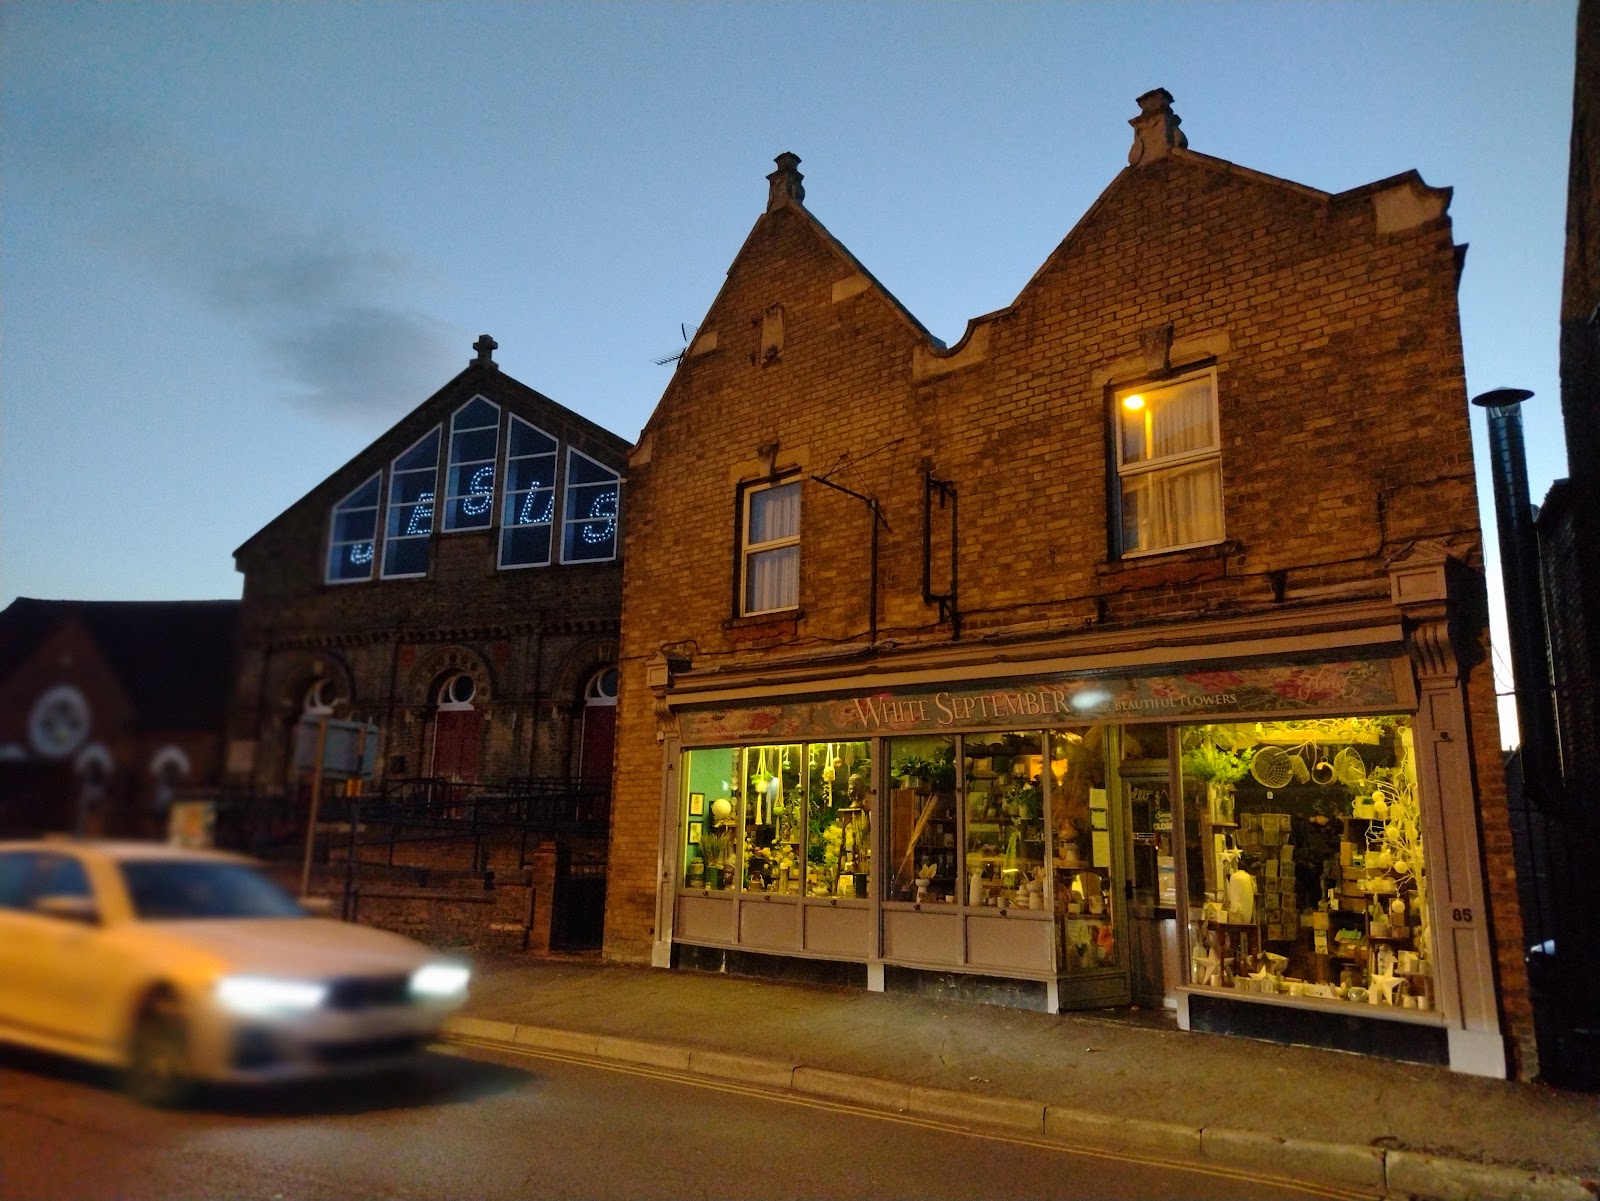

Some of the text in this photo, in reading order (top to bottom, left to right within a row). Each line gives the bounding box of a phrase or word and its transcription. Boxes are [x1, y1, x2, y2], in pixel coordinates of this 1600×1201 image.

[852, 690, 1070, 728] WHITE SEPTEMBER
[1114, 697, 1176, 711] BEAUTIFUL
[1181, 693, 1237, 707] FLOWERS
[1452, 908, 1473, 923] 85
